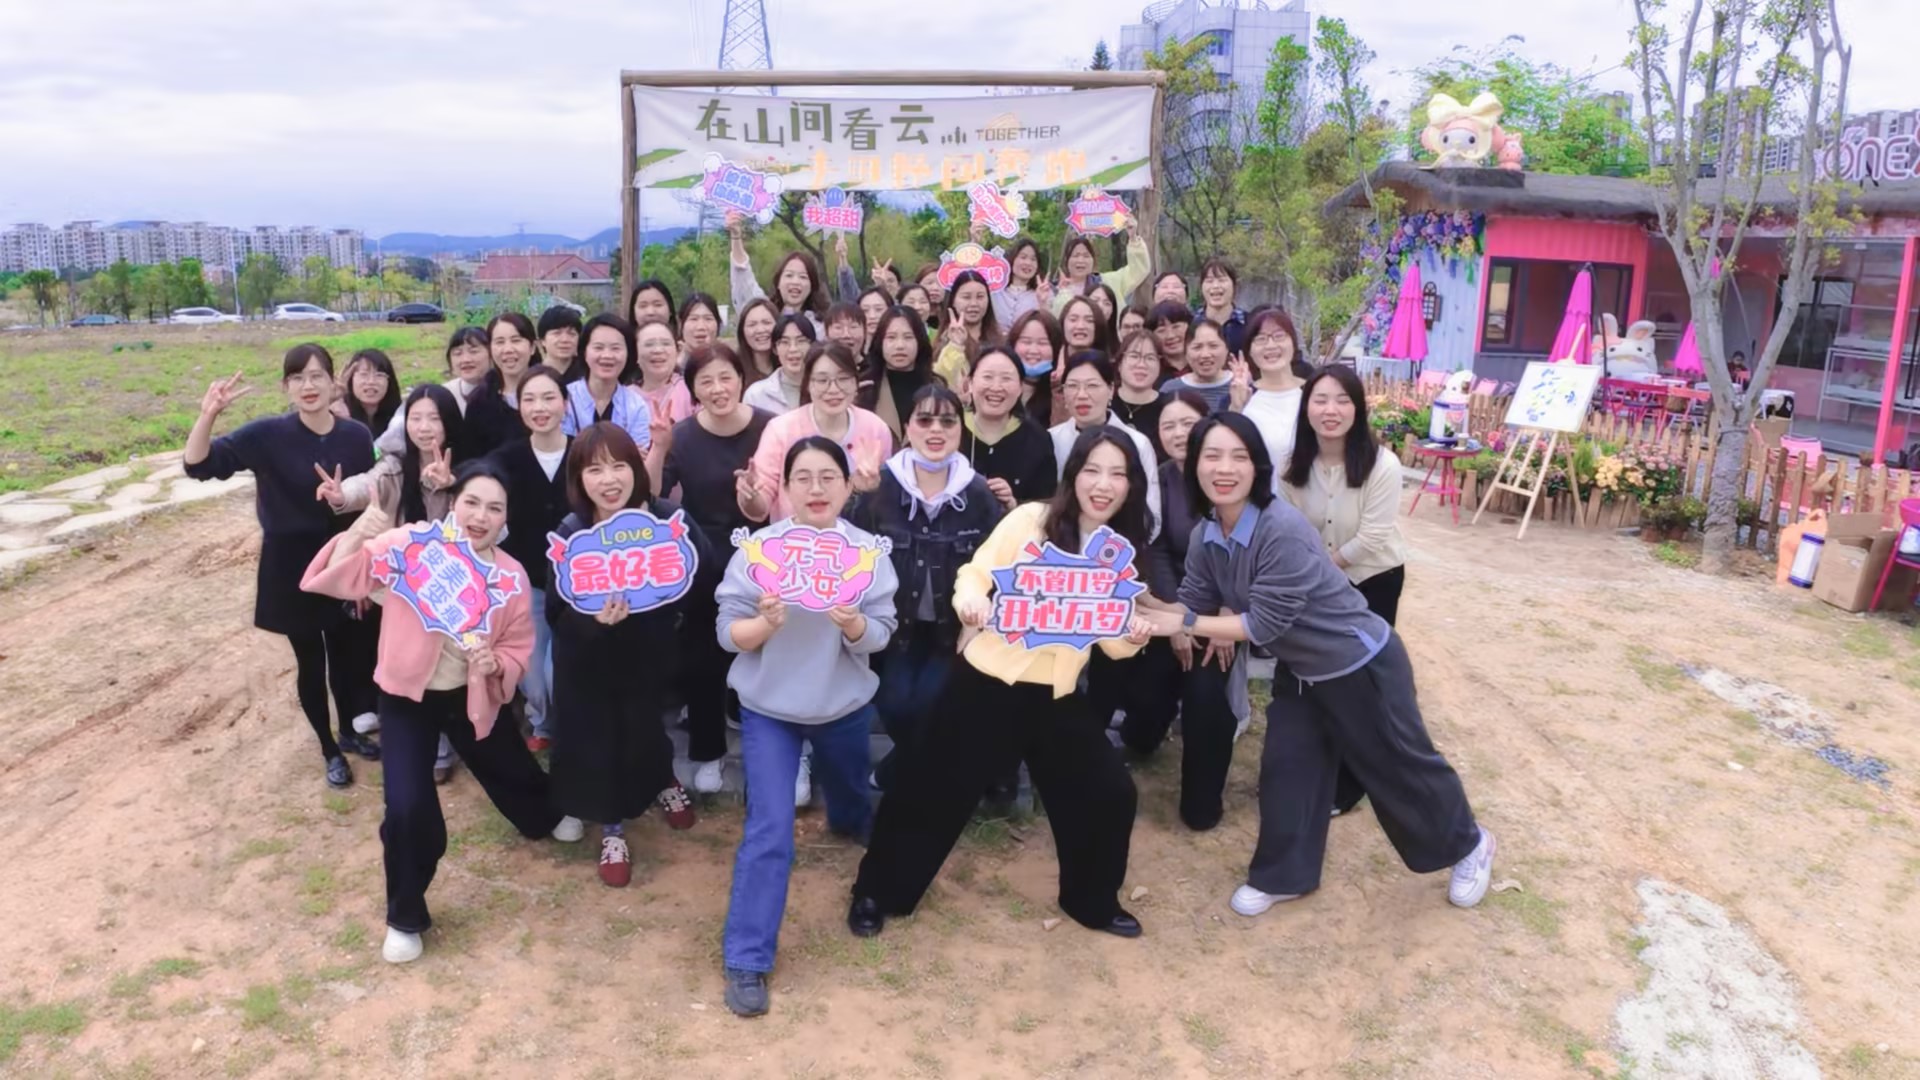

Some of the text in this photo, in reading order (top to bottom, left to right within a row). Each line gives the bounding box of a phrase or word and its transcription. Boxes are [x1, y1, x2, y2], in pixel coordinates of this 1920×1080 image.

[695, 99, 934, 151] 在山间看云
[975, 125, 1060, 142] TOGETHER
[806, 206, 860, 229] 我超甜
[600, 527, 653, 545] Love
[783, 534, 843, 570] 元气
[571, 545, 686, 593] 最好看
[780, 569, 841, 600] 少女
[1019, 569, 1115, 594] 不管几岁
[1002, 598, 1126, 632] 开心万岁
